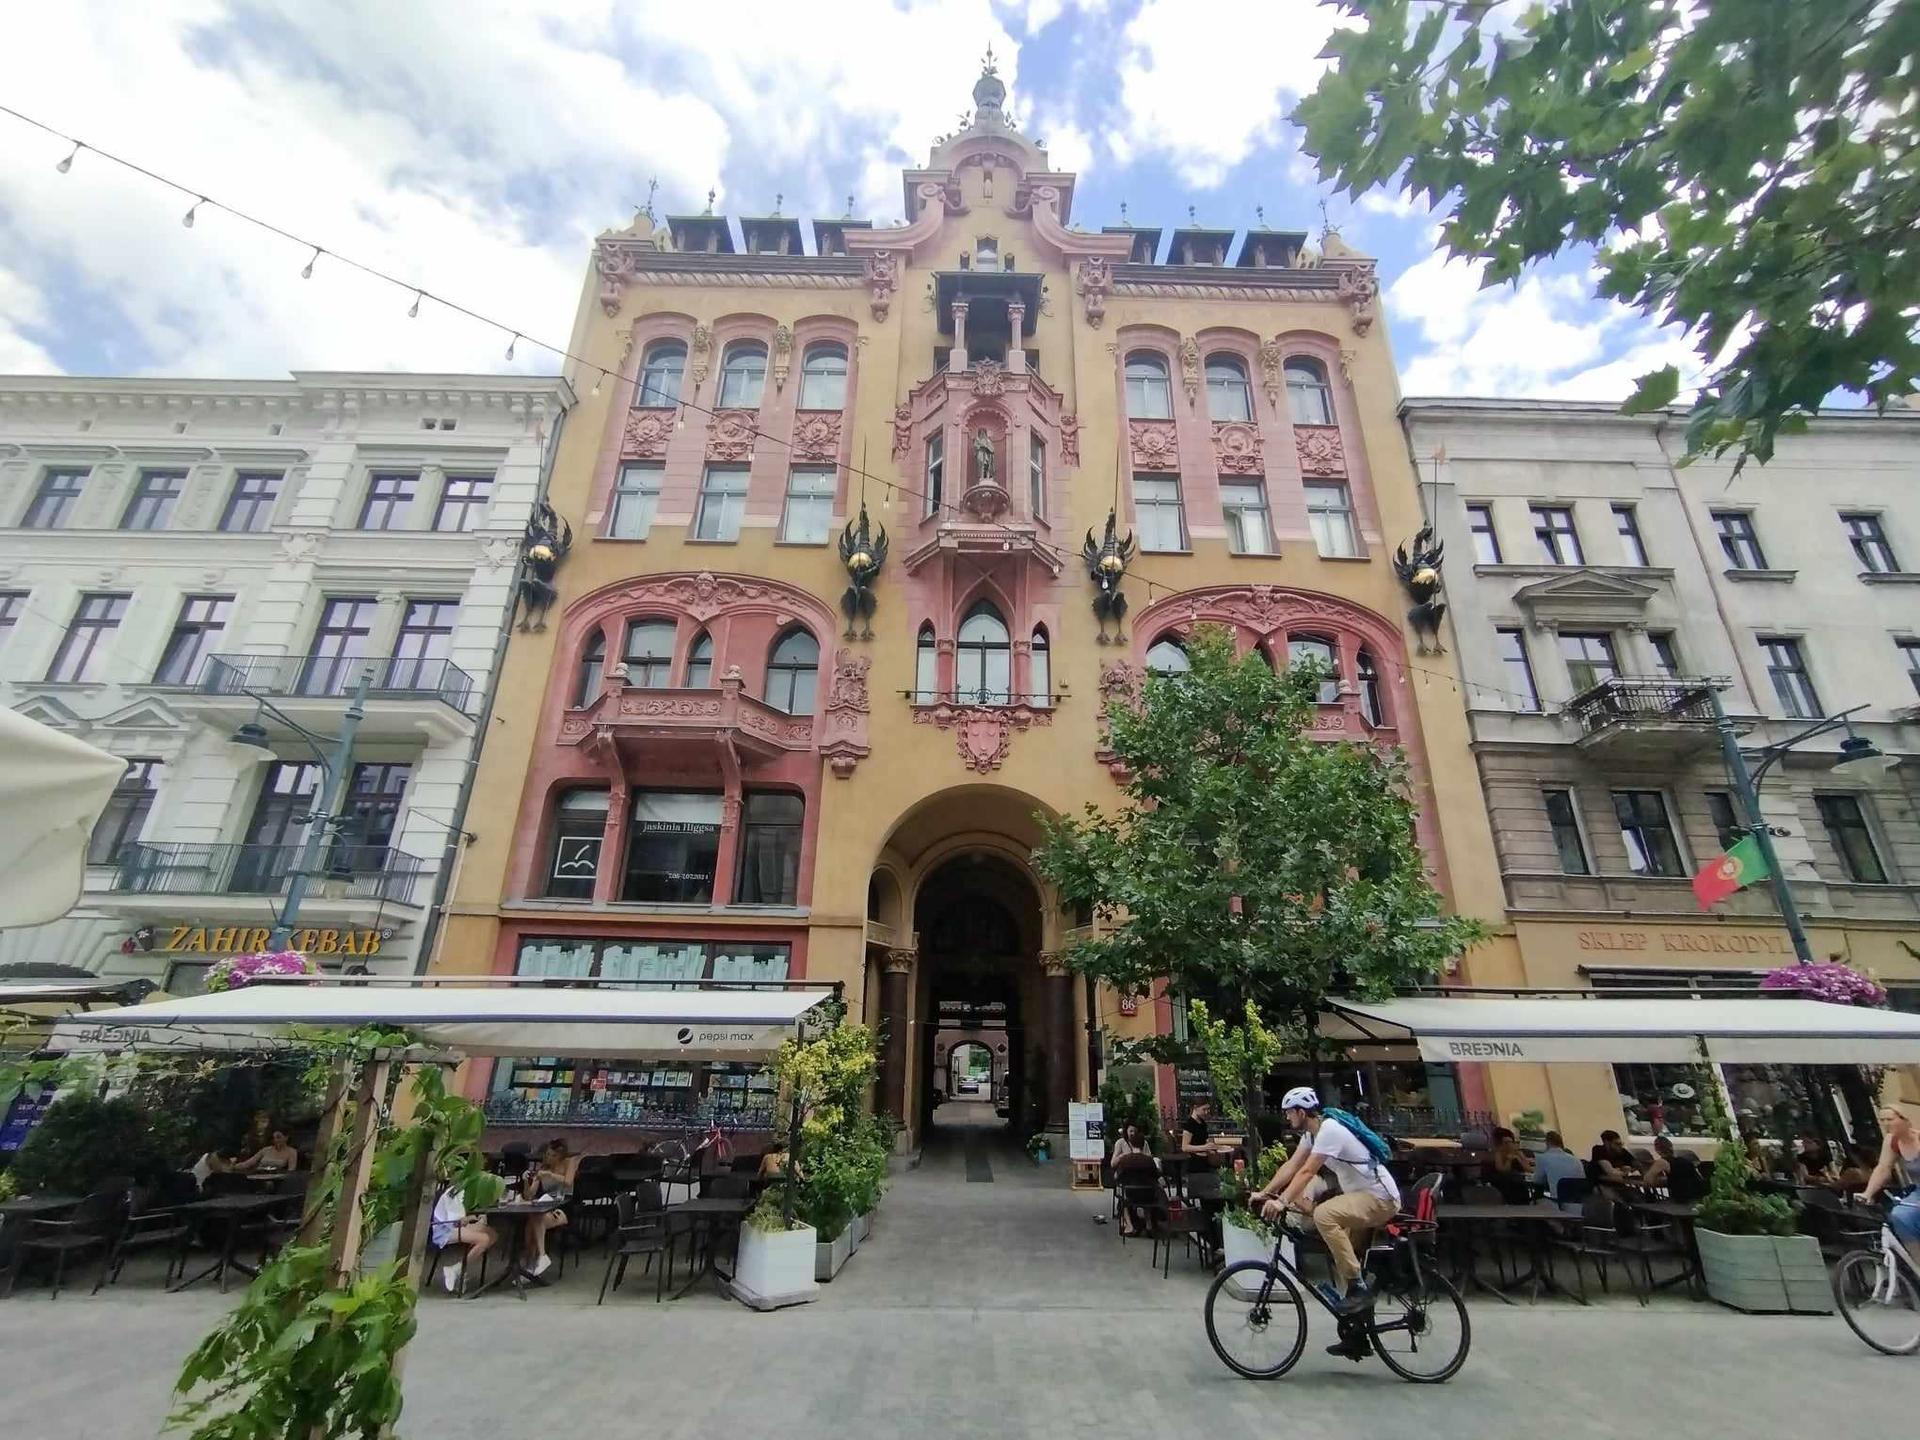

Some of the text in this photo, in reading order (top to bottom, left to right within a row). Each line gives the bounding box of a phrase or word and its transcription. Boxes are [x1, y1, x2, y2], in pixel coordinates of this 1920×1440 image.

[167, 926, 271, 952] ZAHIR
[1577, 931, 1794, 954] SKLEP KROKODYL
[1122, 999, 1136, 1010] 86
[698, 1033, 755, 1043] pepsi max
